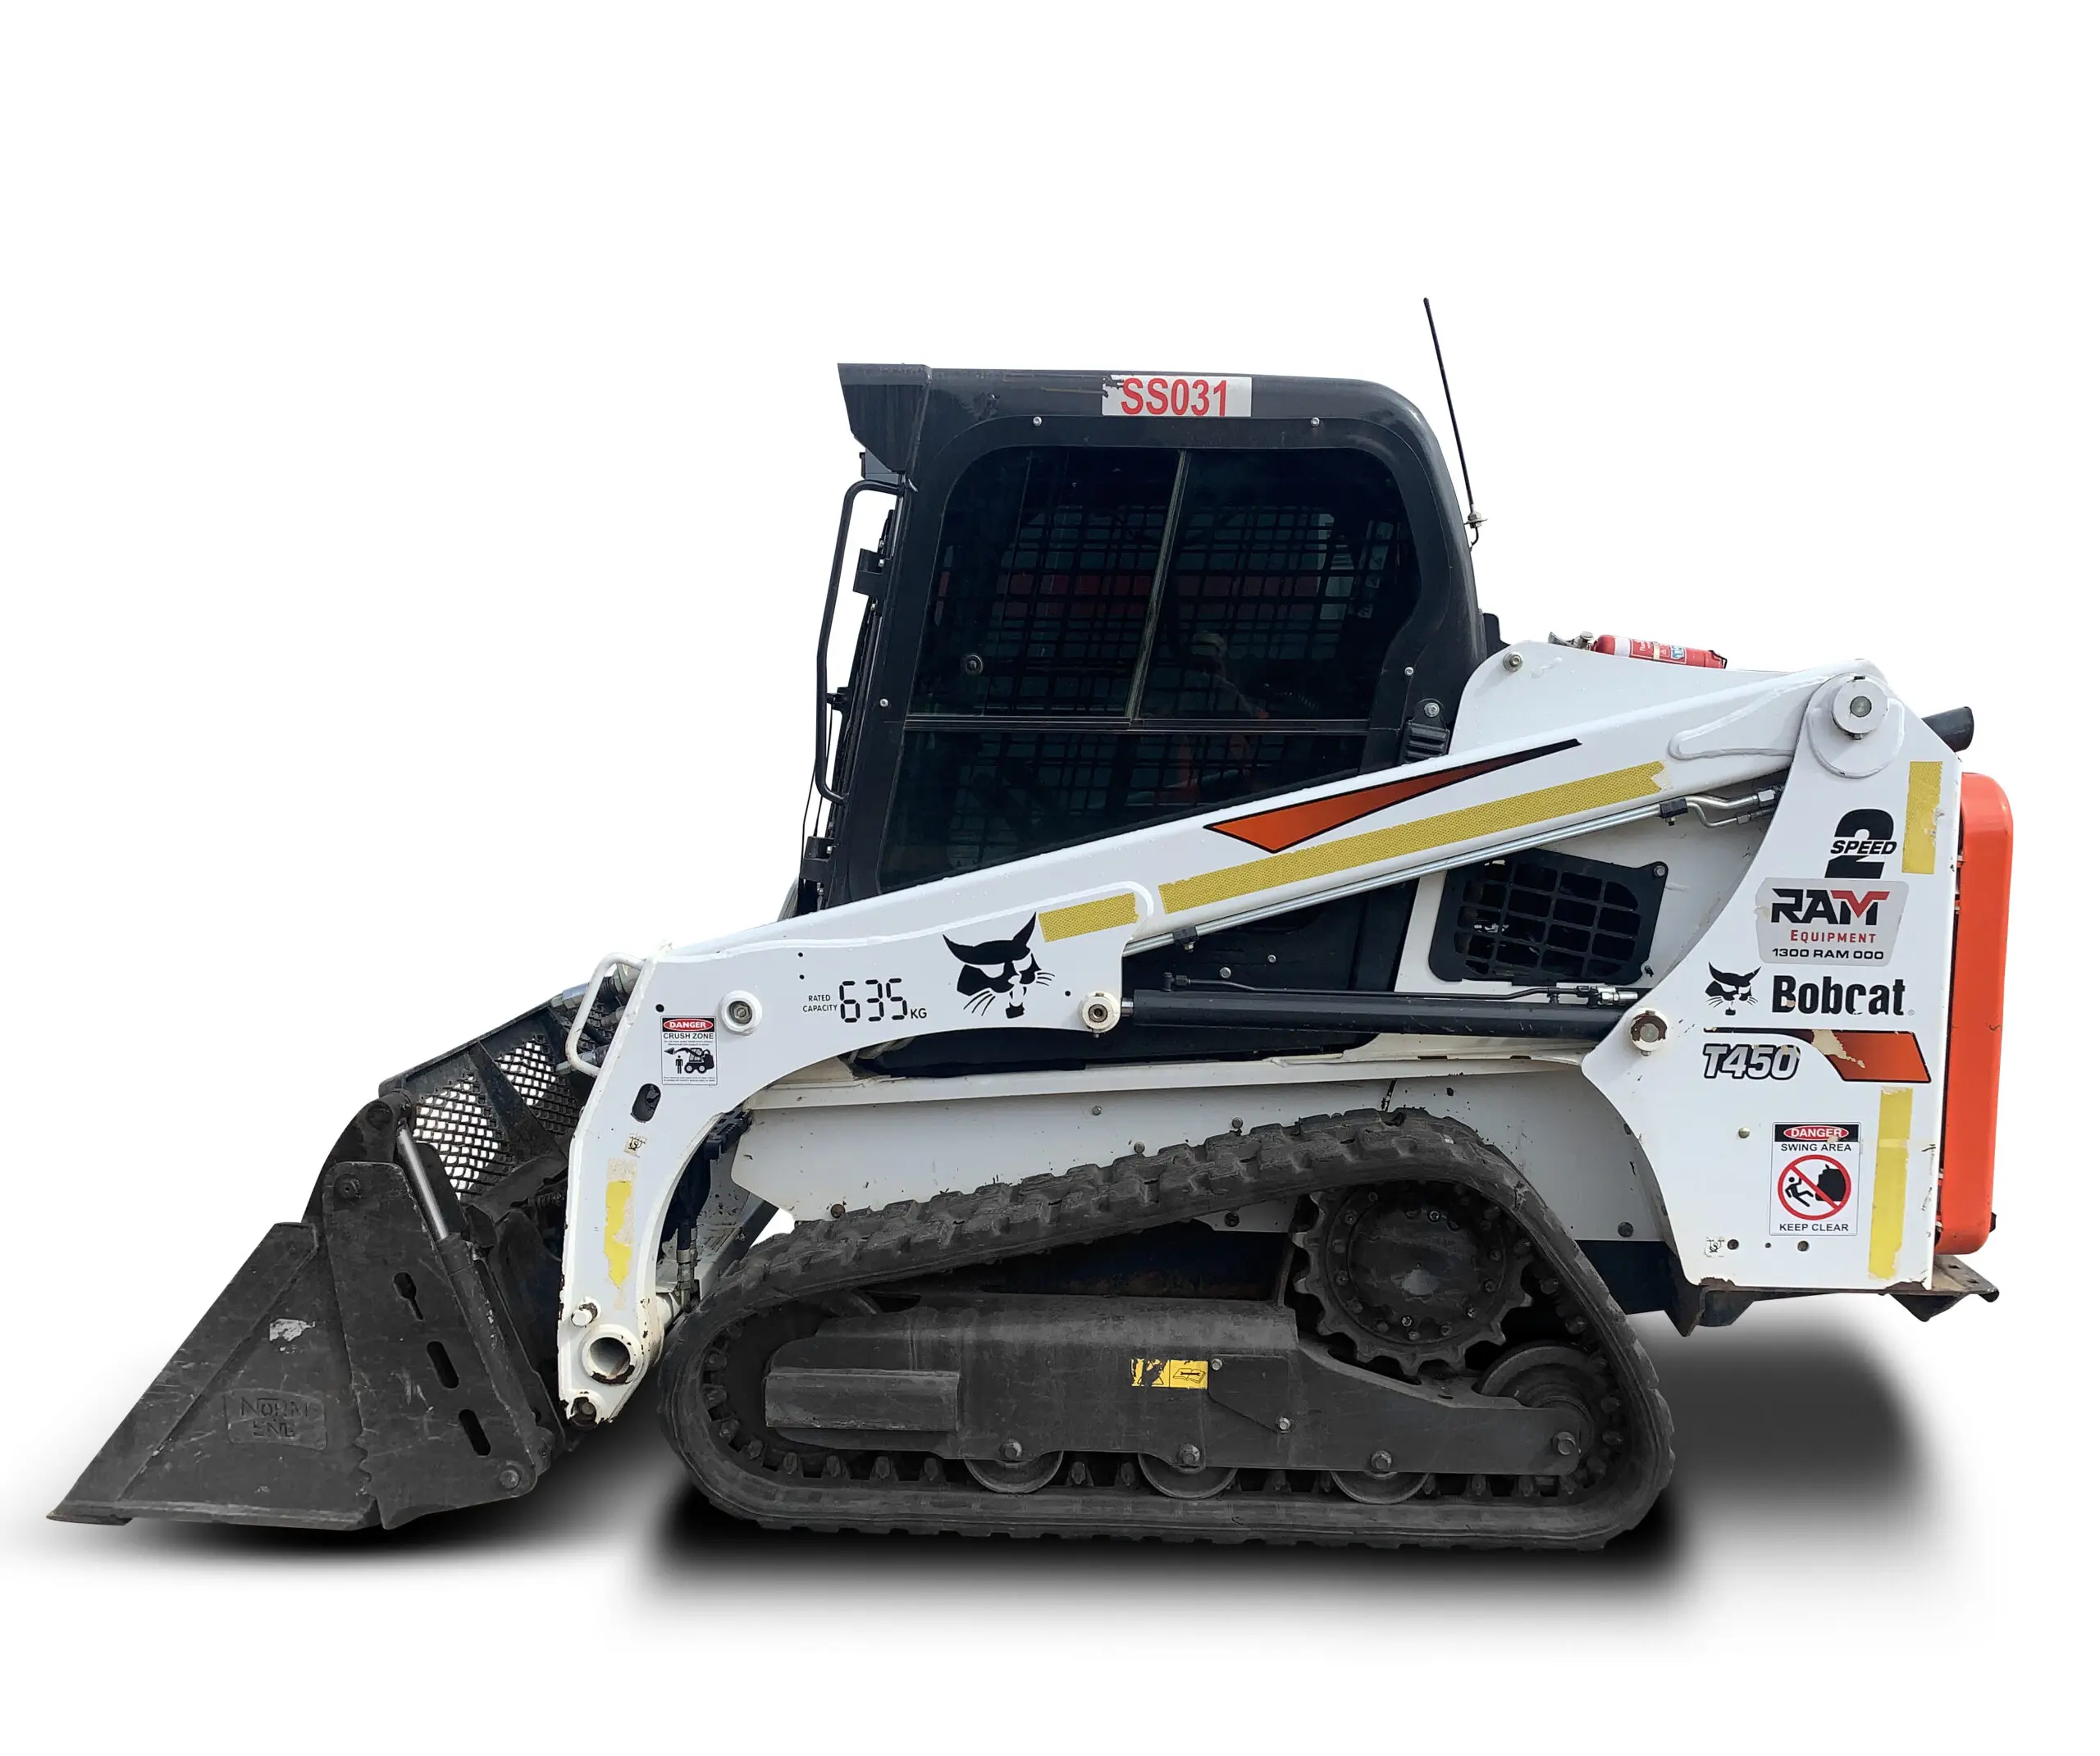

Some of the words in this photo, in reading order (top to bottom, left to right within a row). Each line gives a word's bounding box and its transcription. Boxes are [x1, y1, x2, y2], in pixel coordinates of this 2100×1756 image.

[1121, 377, 1227, 417] SS031
[1824, 809, 1894, 879] 2
[1830, 840, 1897, 855] SPEED
[1771, 888, 1890, 925] RAM
[1790, 929, 1877, 943] EQUIPMENT
[1772, 948, 1810, 958] 1300
[1813, 949, 1849, 959] RAM
[1853, 951, 1884, 960] 000
[808, 994, 831, 1002] RATED
[839, 978, 908, 1024] 635
[911, 1008, 928, 1019] KG
[1772, 975, 1906, 1015] Bobcat
[802, 1004, 838, 1013] CAPACITY
[1703, 1043, 1801, 1081] T450
[1790, 1128, 1842, 1138] DANGER
[1781, 1143, 1818, 1152] SWING
[1820, 1143, 1852, 1152] AREA
[1779, 1223, 1809, 1231] KEEP
[1811, 1223, 1849, 1231] CLEAR
